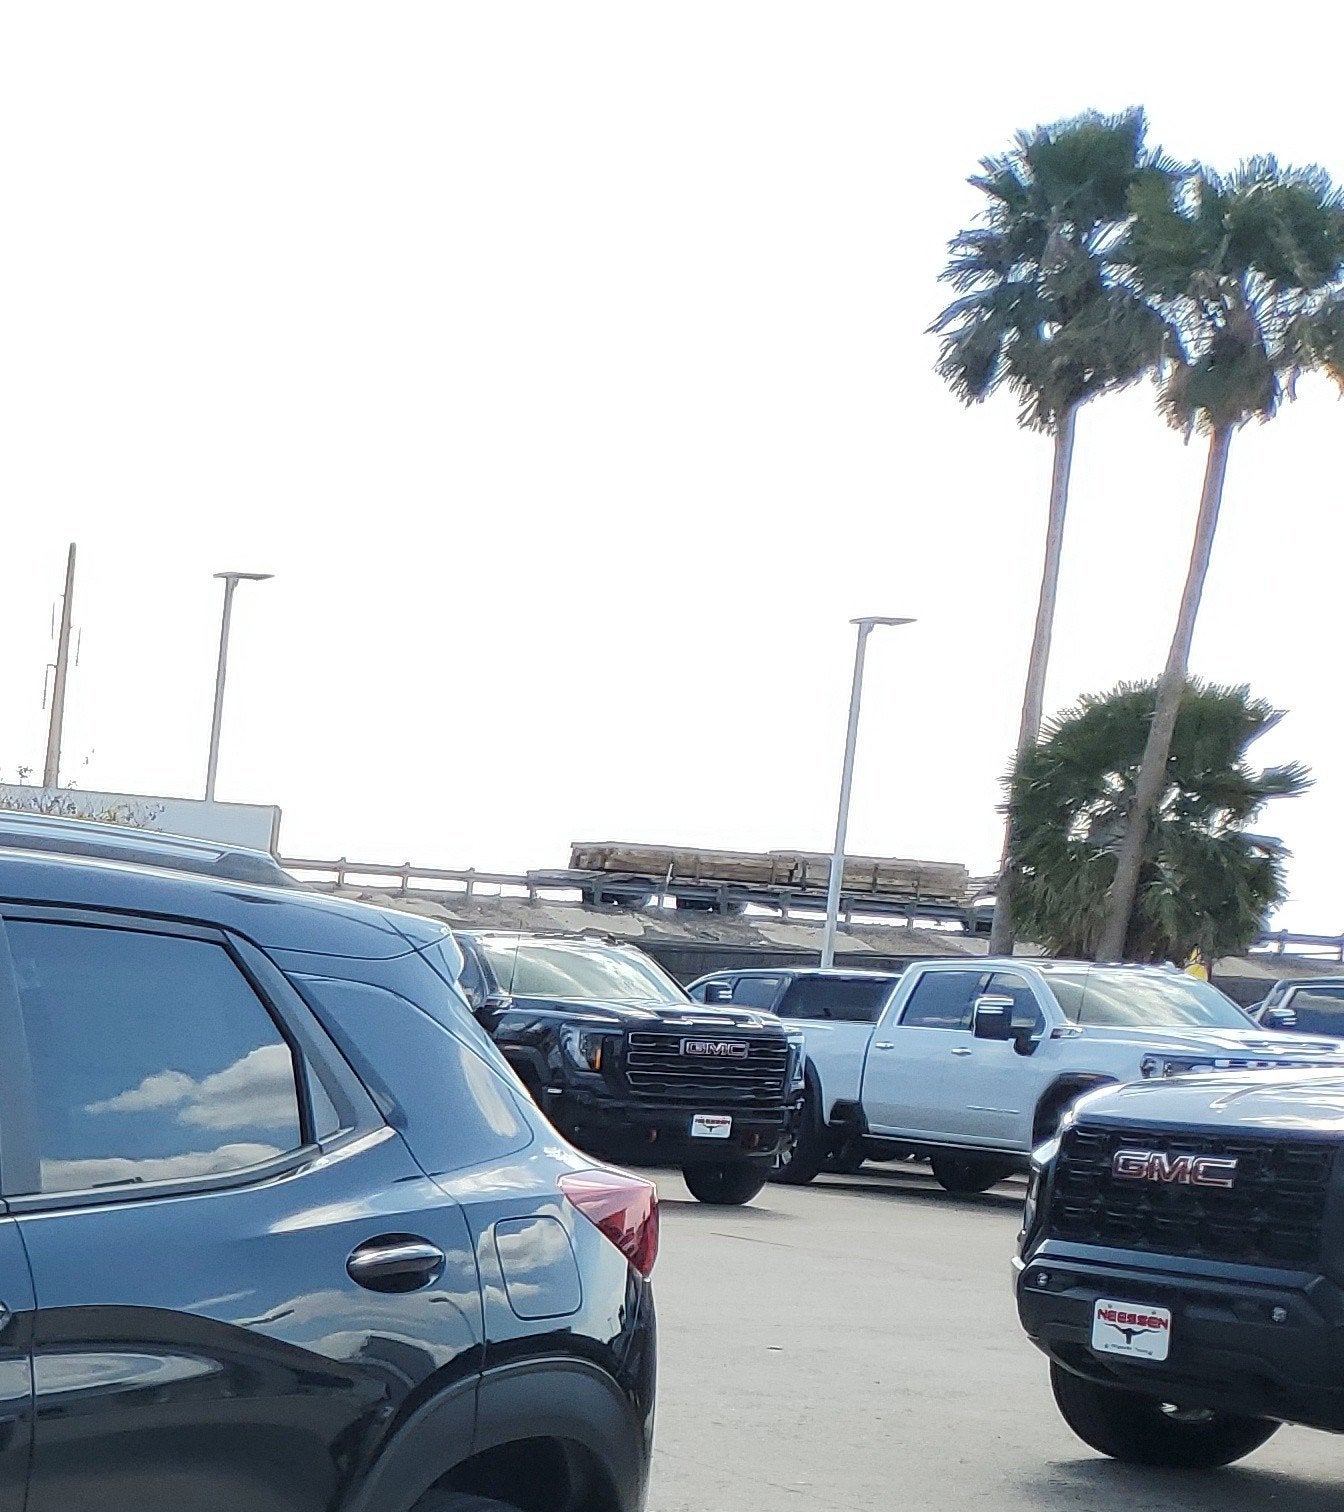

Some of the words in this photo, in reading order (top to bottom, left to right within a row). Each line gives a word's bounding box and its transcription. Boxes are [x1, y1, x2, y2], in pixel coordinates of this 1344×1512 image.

[686, 1041, 748, 1056] GMC
[1113, 1150, 1238, 1188] GMC
[1097, 1308, 1169, 1331] NEESSEN
